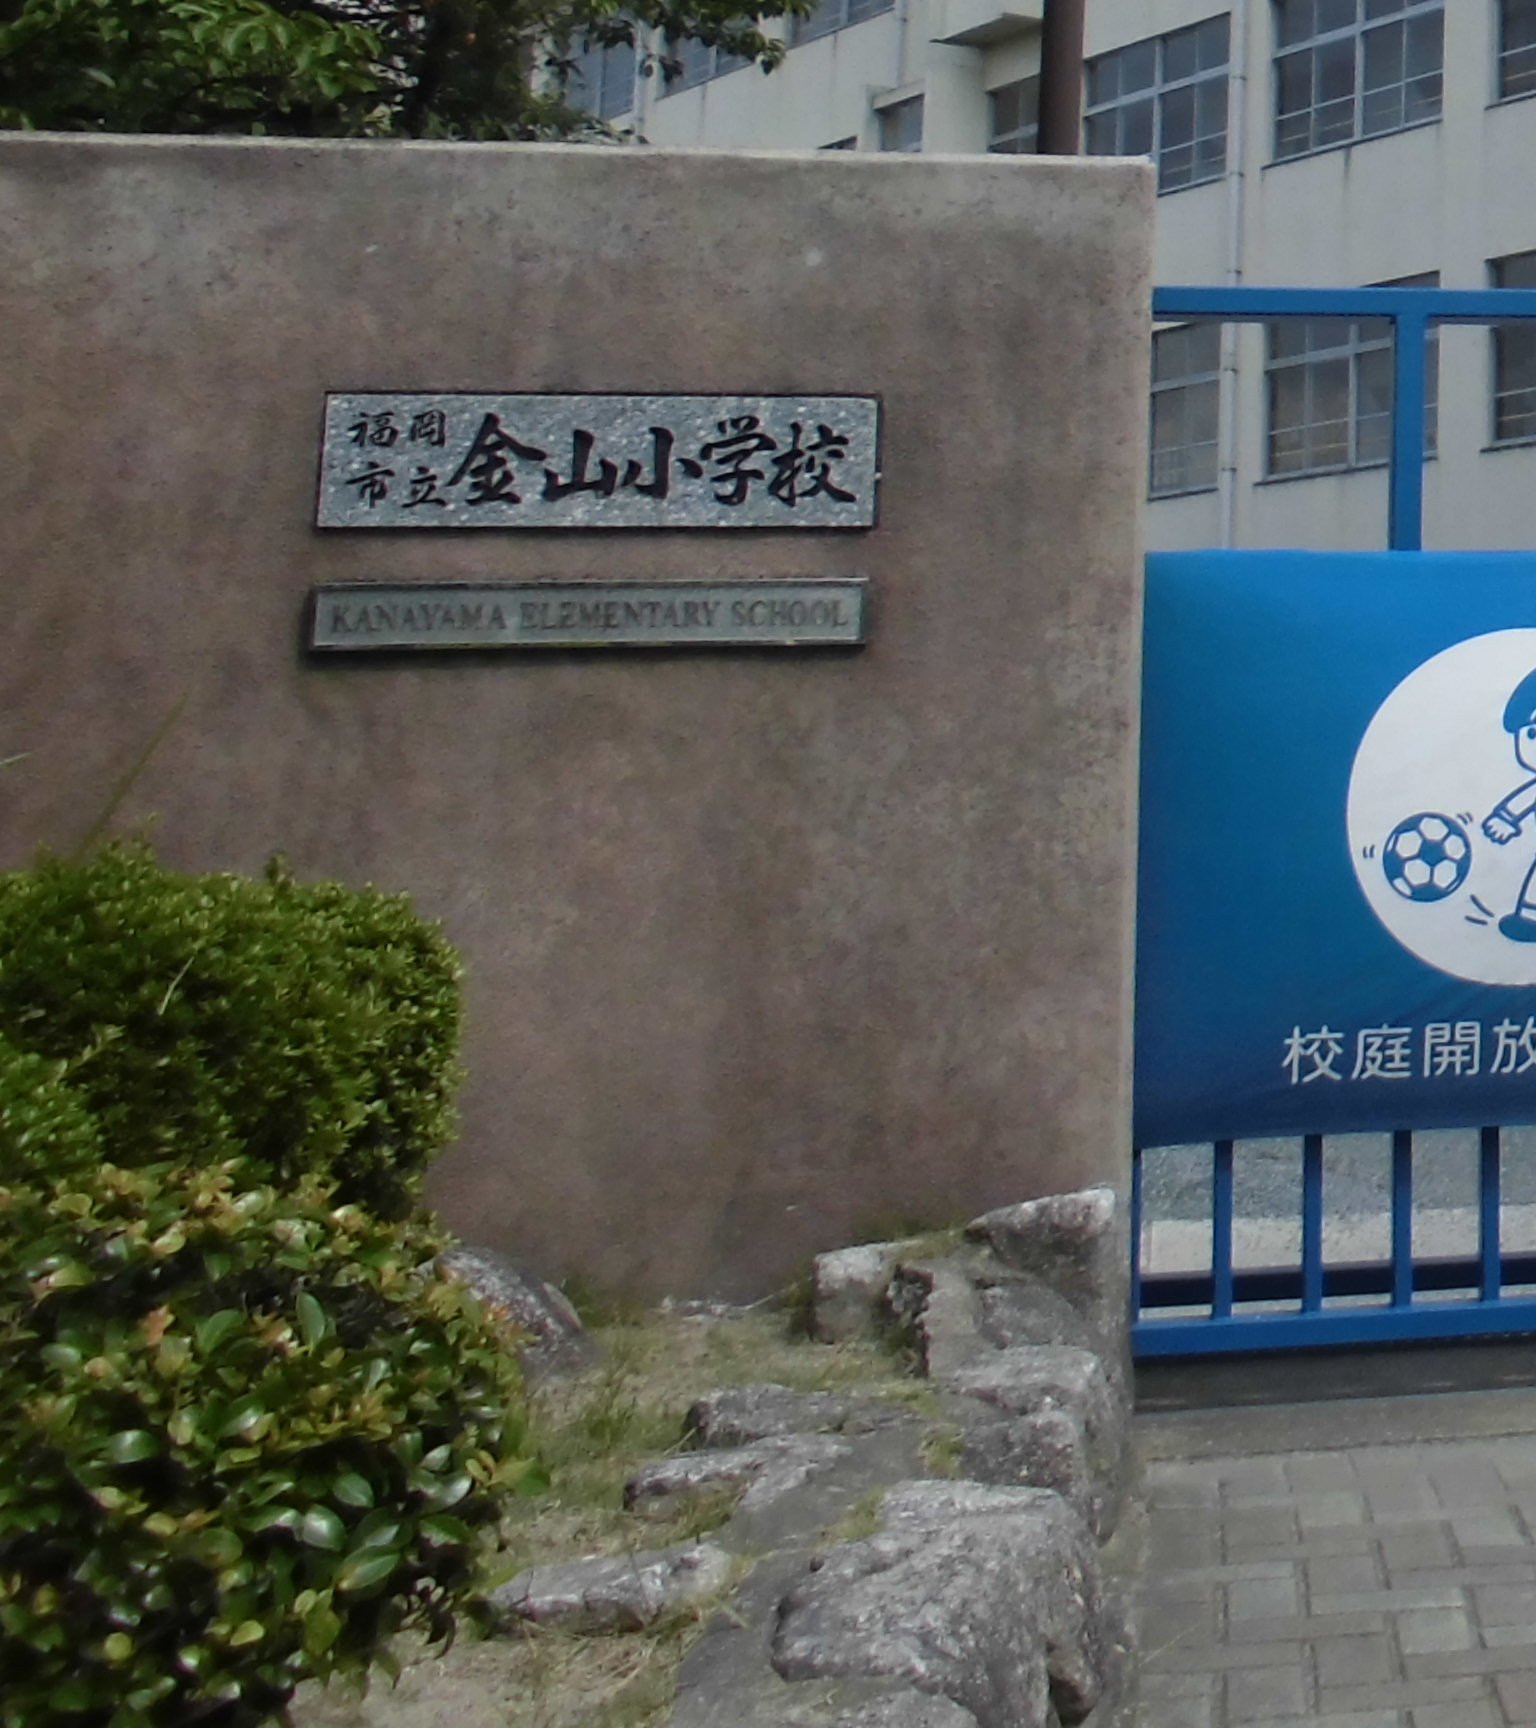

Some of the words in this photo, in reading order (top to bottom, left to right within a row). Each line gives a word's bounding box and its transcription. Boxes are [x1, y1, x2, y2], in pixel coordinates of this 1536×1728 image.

[346, 410, 447, 449] 福岡
[445, 412, 858, 509] 金山小学校
[345, 462, 447, 510] 市立
[330, 603, 508, 634] KANAYAMA
[519, 600, 721, 631] ELEMENTARY
[732, 599, 850, 629] SCHOOL
